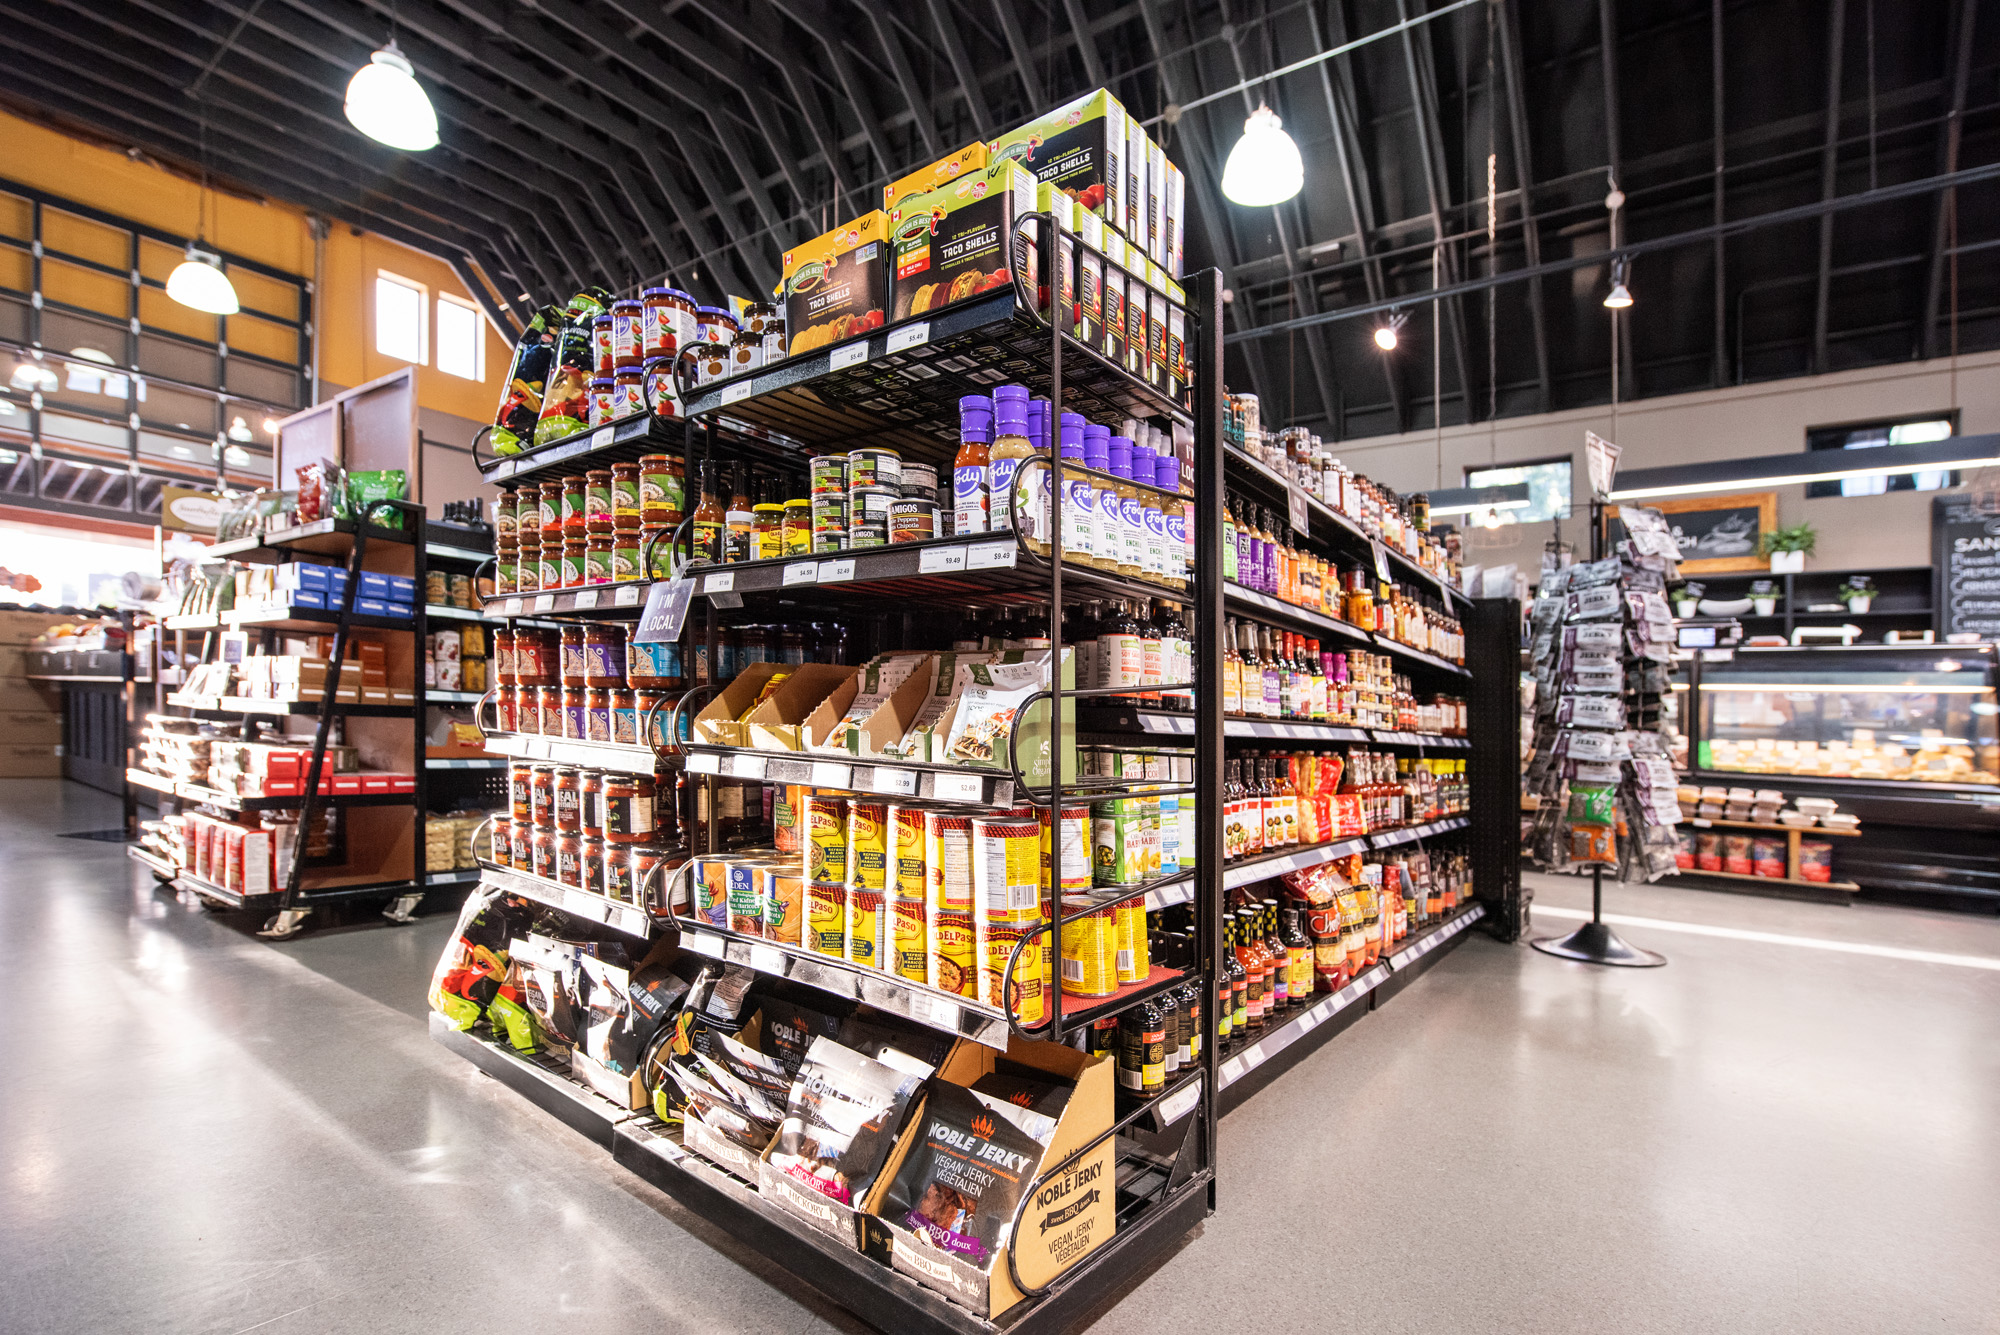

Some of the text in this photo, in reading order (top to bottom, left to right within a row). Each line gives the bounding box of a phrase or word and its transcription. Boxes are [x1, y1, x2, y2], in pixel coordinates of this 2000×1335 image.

[1016, 145, 1028, 153] BEST
[1039, 153, 1090, 180] TACO SHELLS
[897, 217, 931, 236] FRESH IS BEST
[900, 245, 904, 253] 4
[942, 232, 996, 258] TACO SHELLS
[900, 256, 904, 264] 4
[791, 265, 824, 287] FRESH IS BEST
[900, 268, 904, 276] 4
[809, 298, 825, 310] TACO
[826, 288, 850, 304] SHELLS
[909, 332, 924, 342] $5.49
[954, 468, 980, 485] Fody
[892, 504, 918, 514] AMIGOS
[992, 507, 1008, 518] CHILAD
[956, 512, 968, 522] TACO
[896, 522, 919, 530] Chipotle
[946, 556, 960, 564] $9.49
[994, 552, 1010, 560] $9.49
[658, 594, 676, 610] I'M
[1584, 594, 1612, 604] JERKY
[644, 614, 674, 632] LOCAL
[1579, 704, 1610, 712] JERKY
[1034, 758, 1052, 770] simpl
[1032, 766, 1051, 777] Organ
[560, 792, 578, 802] EAL
[560, 852, 575, 865] EAL
[730, 880, 750, 890] EDEN
[740, 897, 758, 905] Kidne
[1010, 944, 1032, 958] Pso
[780, 1050, 800, 1063] VEGAN
[704, 1138, 740, 1162] TERIYAKI
[928, 1122, 1032, 1174] NOBLE JERKY
[934, 1152, 996, 1188] VEGAN JERKY
[792, 1166, 826, 1191] HICKORY
[936, 1169, 983, 1198] VÉGÉTALIEN
[1036, 1160, 1104, 1211] NOBLE JERKY
[788, 1188, 824, 1217] HICKORY
[1064, 1203, 1079, 1219] BBQ
[928, 1224, 951, 1246] BBQ
[951, 1238, 972, 1250] doux
[1048, 1216, 1095, 1255] VEGAN JERKY
[1055, 1234, 1090, 1264] VÉGÉTALIEN
[913, 1254, 932, 1275] BBQ
[932, 1266, 948, 1278] doux
